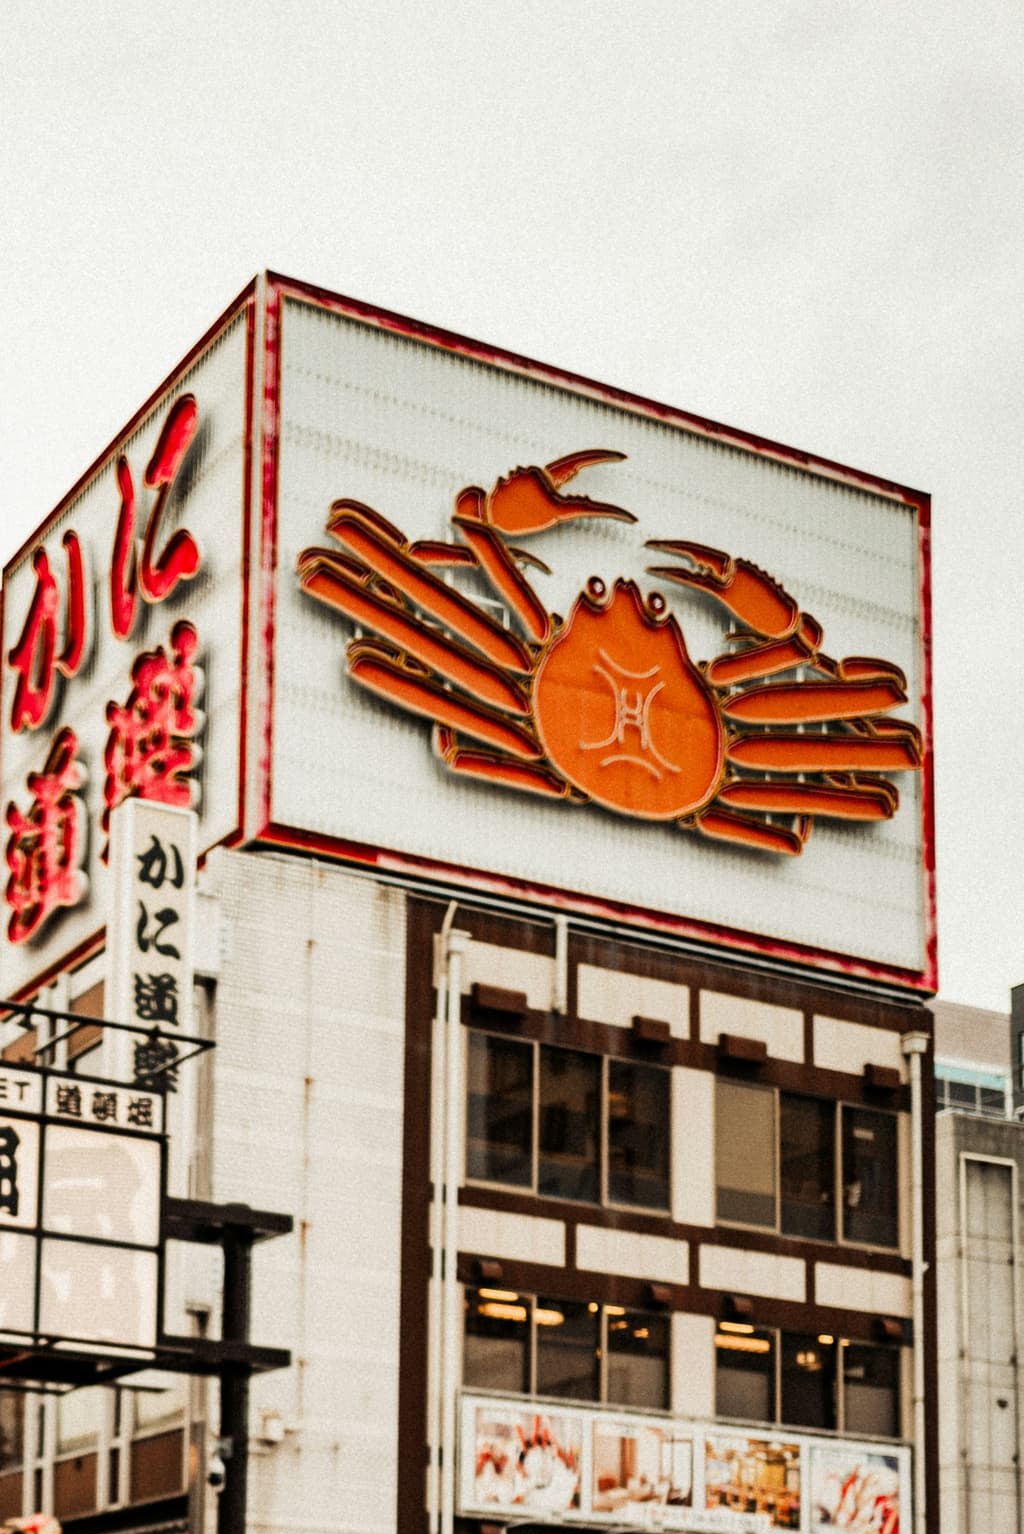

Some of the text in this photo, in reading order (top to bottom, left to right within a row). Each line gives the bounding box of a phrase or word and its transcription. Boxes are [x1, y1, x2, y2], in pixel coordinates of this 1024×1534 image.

[6, 393, 200, 736] かに
[56, 1083, 154, 1128] 道頓堀
